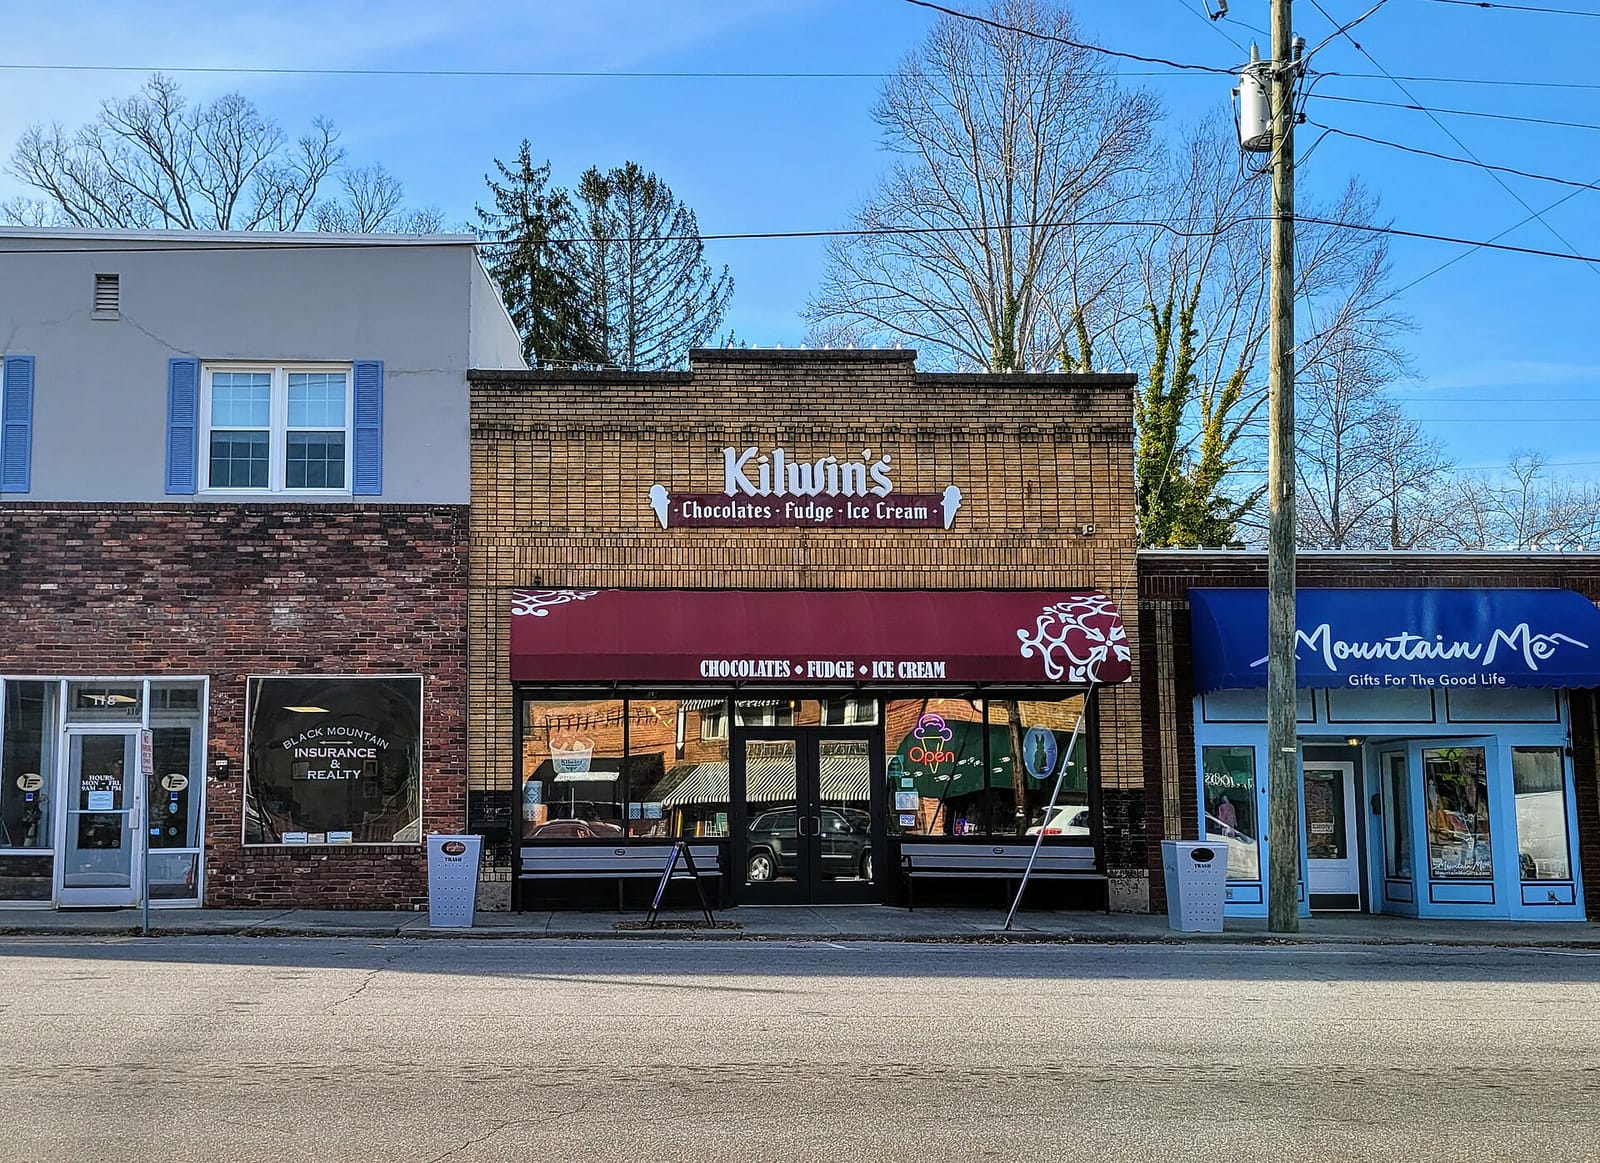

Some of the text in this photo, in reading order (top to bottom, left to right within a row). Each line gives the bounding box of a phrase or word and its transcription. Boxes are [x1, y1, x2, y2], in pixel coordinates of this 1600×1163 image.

[723, 446, 893, 498] Kilwin's
[682, 501, 928, 521] Chocolates Fudge Ice Cream
[1295, 622, 1557, 671] Mountain Me
[700, 659, 946, 679] CHOCOLATES FUDGE ICE CREAM
[1348, 673, 1506, 687] Gifts For The Good Life
[93, 695, 116, 706] 118
[282, 726, 390, 750] BLACK MOUNTAIN
[294, 748, 377, 758] INSURANCE
[909, 746, 955, 766] Open
[330, 759, 341, 769] &
[307, 770, 362, 780] REALTY
